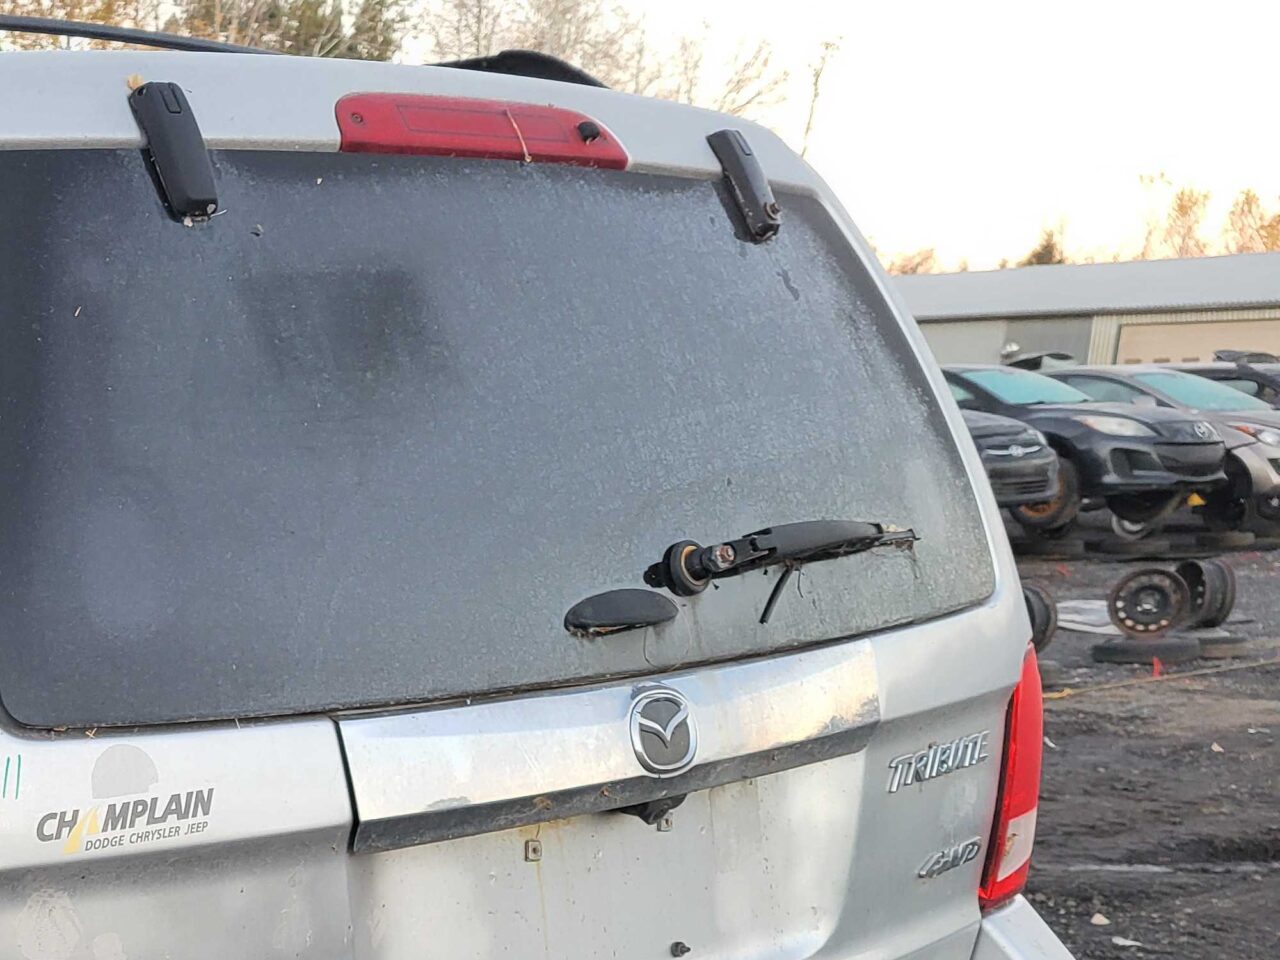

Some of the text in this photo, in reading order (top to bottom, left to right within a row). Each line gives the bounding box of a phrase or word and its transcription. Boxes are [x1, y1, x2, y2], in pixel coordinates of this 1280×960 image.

[887, 730, 990, 793] TRIBUTE
[36, 788, 214, 845] CHAMPLAIN
[85, 820, 209, 852] DODGE CHRYSLER JEEP
